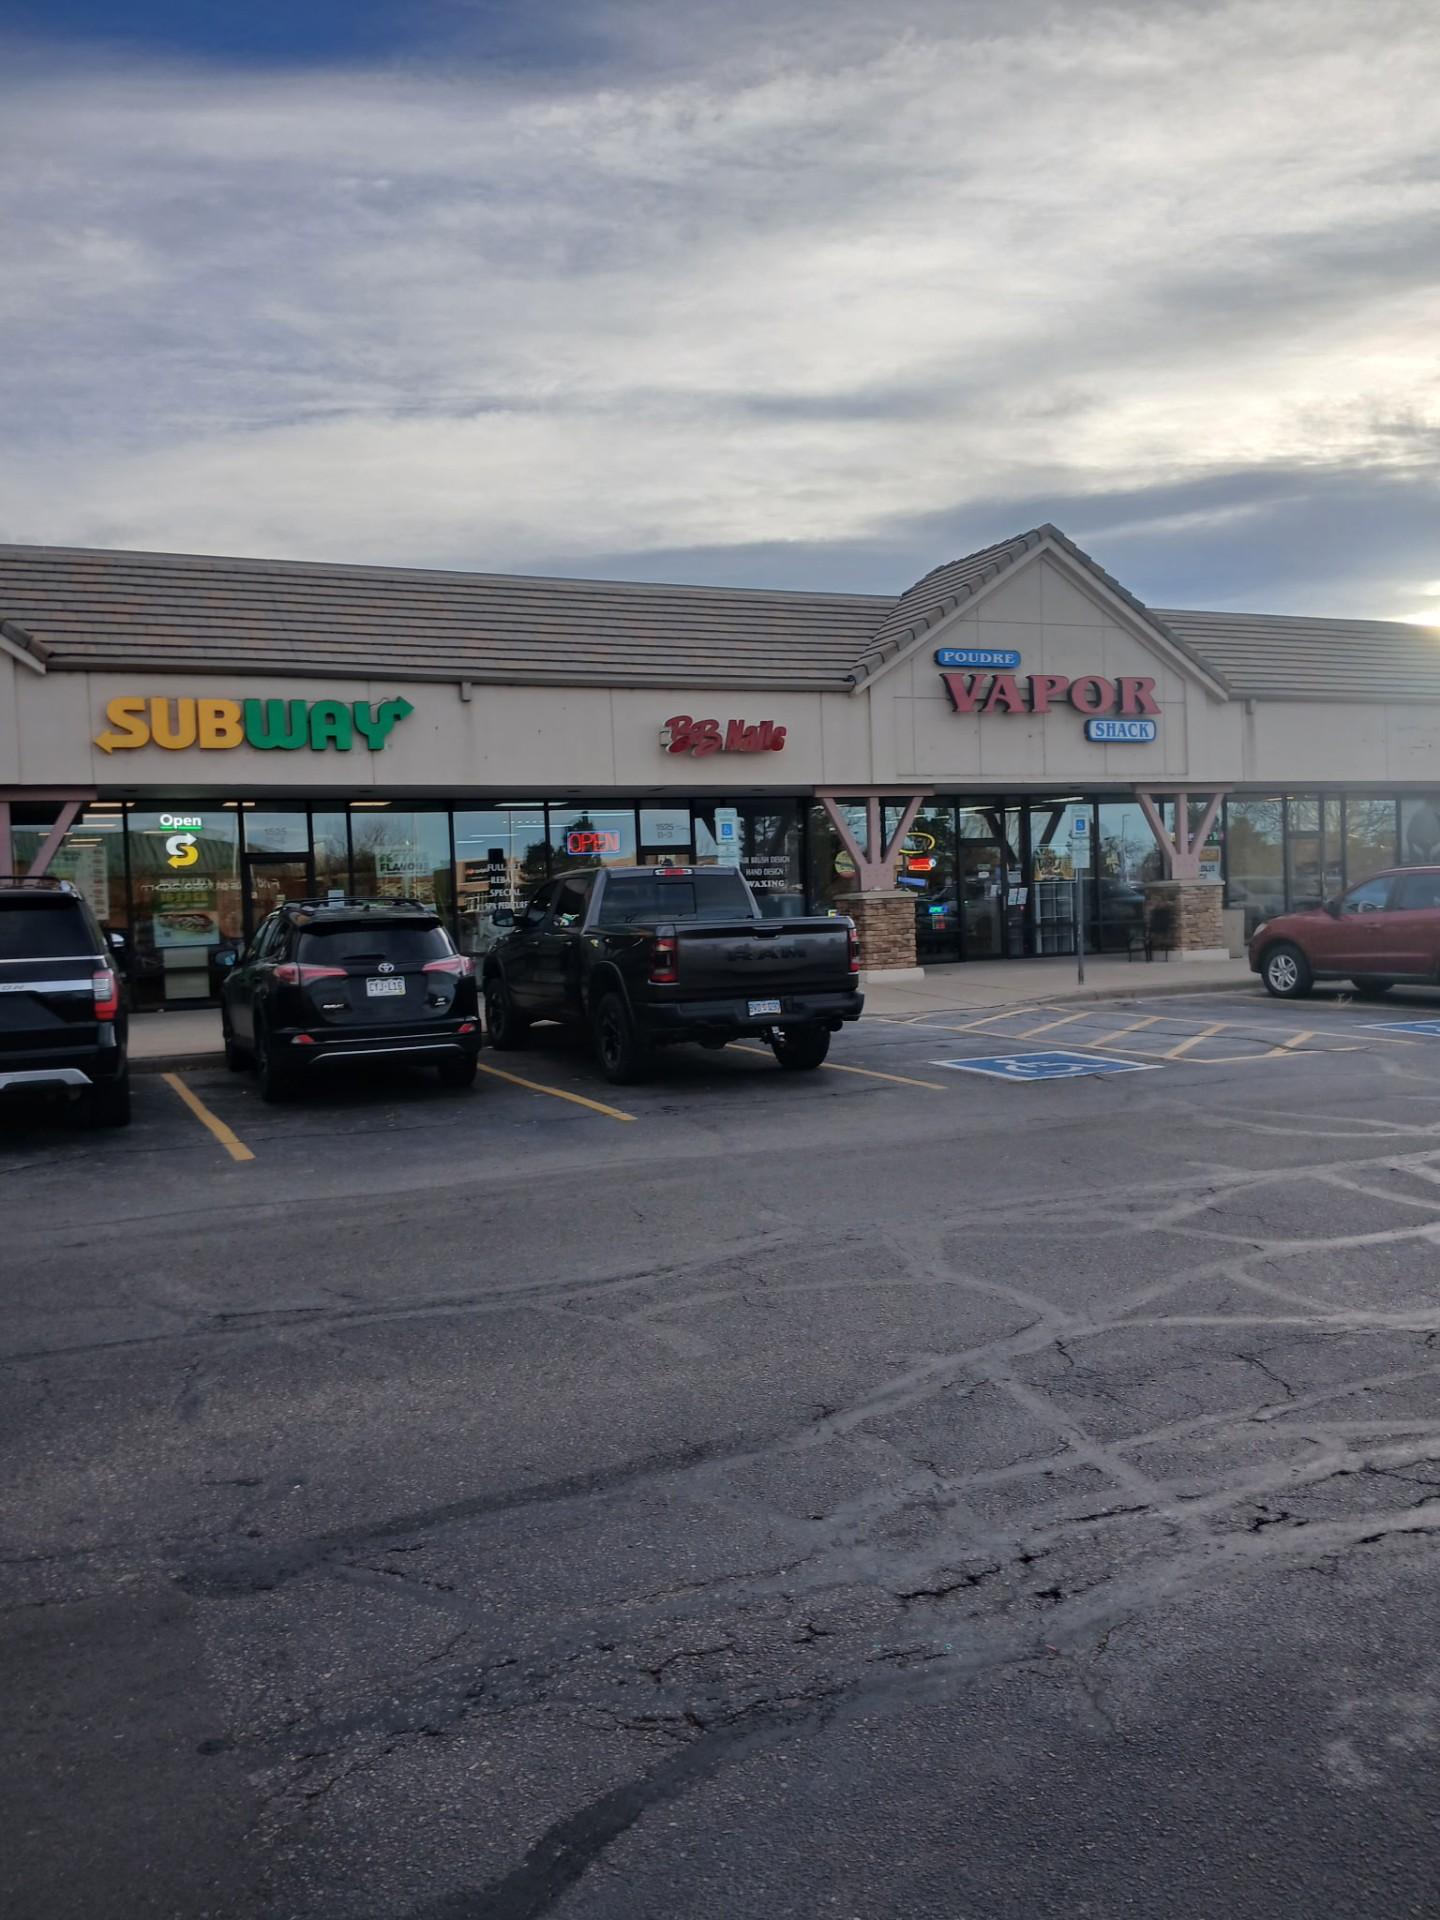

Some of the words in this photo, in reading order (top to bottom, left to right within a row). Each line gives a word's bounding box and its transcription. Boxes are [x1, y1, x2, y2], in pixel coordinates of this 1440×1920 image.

[943, 651, 1015, 664] POUDRE
[940, 672, 1162, 714] VAPOR
[93, 695, 415, 753] SUBWAY
[1095, 722, 1150, 738] SHACK
[724, 719, 787, 752] Nails
[160, 814, 202, 830] Open
[569, 832, 619, 852] OPEN
[746, 880, 785, 888] WAXING
[727, 945, 807, 962] RAM
